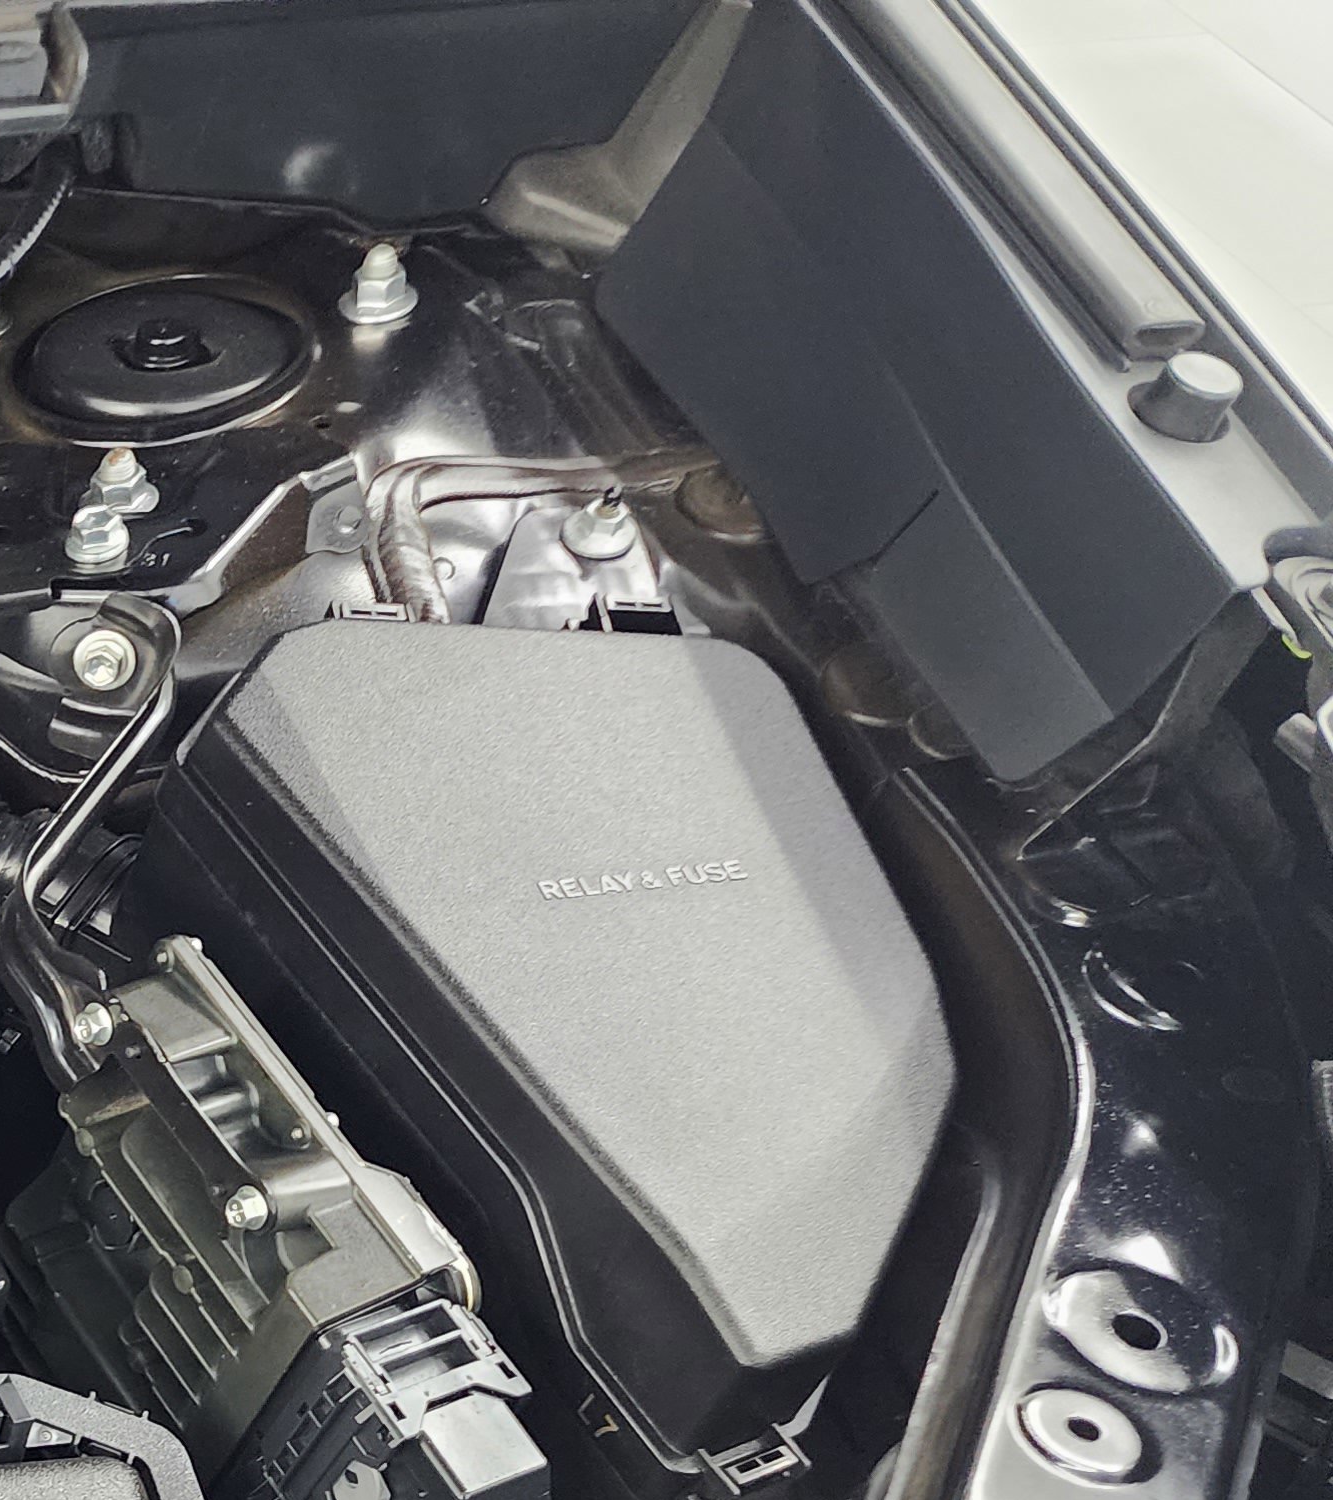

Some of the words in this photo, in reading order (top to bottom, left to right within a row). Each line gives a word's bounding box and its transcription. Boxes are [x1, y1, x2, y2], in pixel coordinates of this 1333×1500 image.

[536, 870, 634, 902] RELAY
[640, 869, 663, 890] &
[663, 859, 749, 887] FUSE
